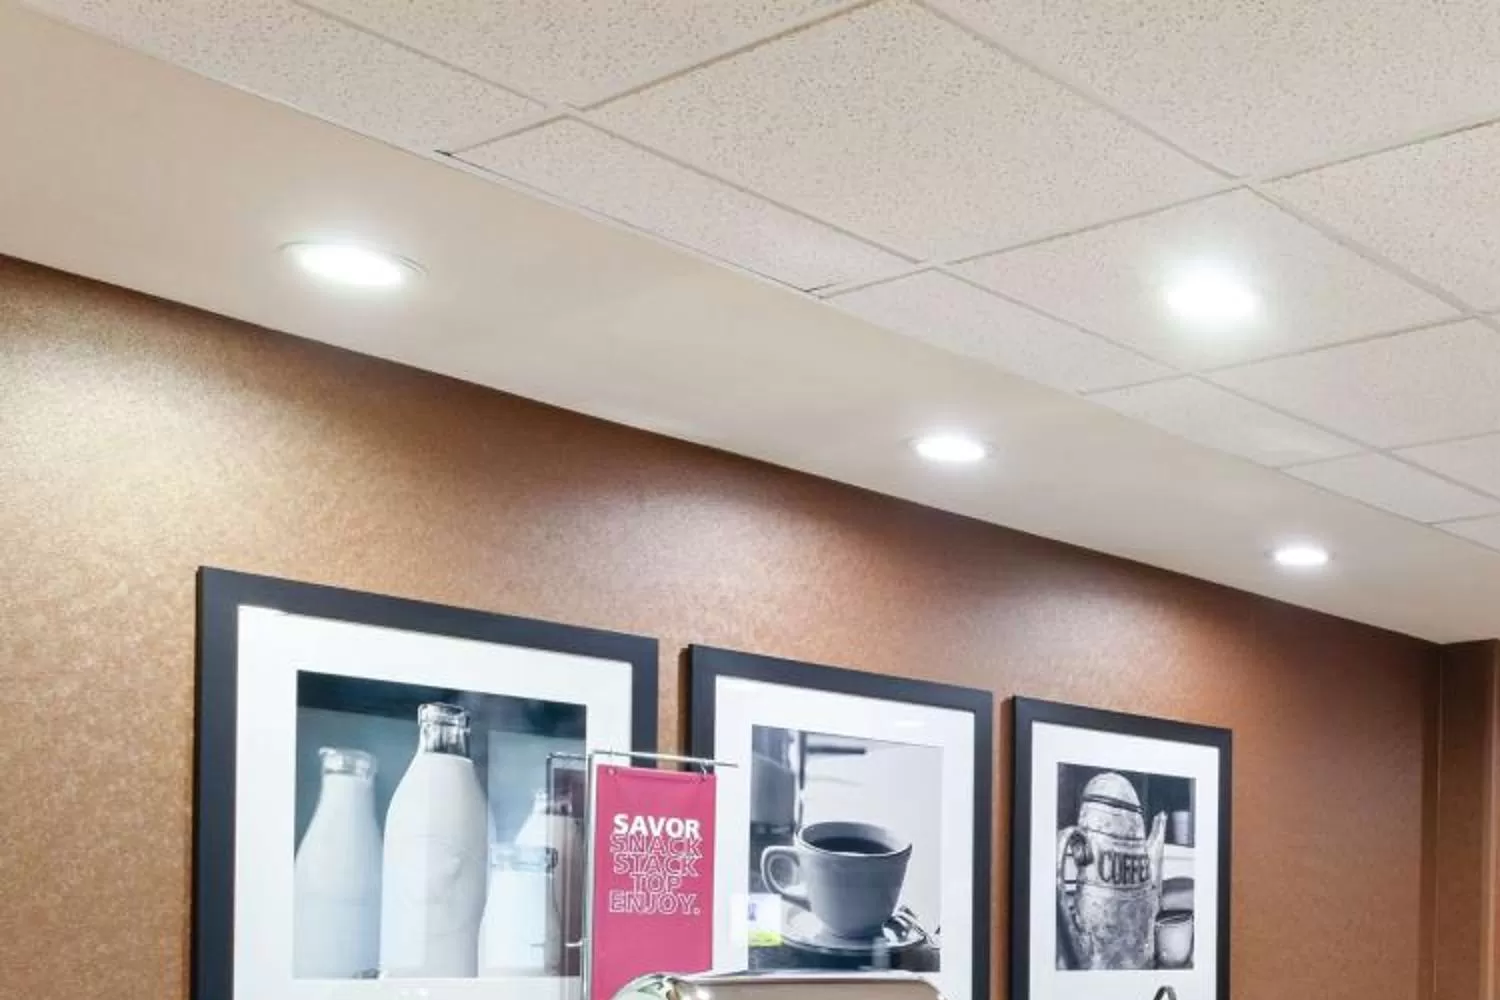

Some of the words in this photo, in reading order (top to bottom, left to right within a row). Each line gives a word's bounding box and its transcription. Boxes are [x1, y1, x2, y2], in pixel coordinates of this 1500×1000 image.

[613, 813, 702, 839] SAVOR
[609, 832, 704, 859] SNACK
[613, 852, 700, 877] STACK
[629, 872, 682, 894] TOP
[608, 889, 702, 915] ENJOY.
